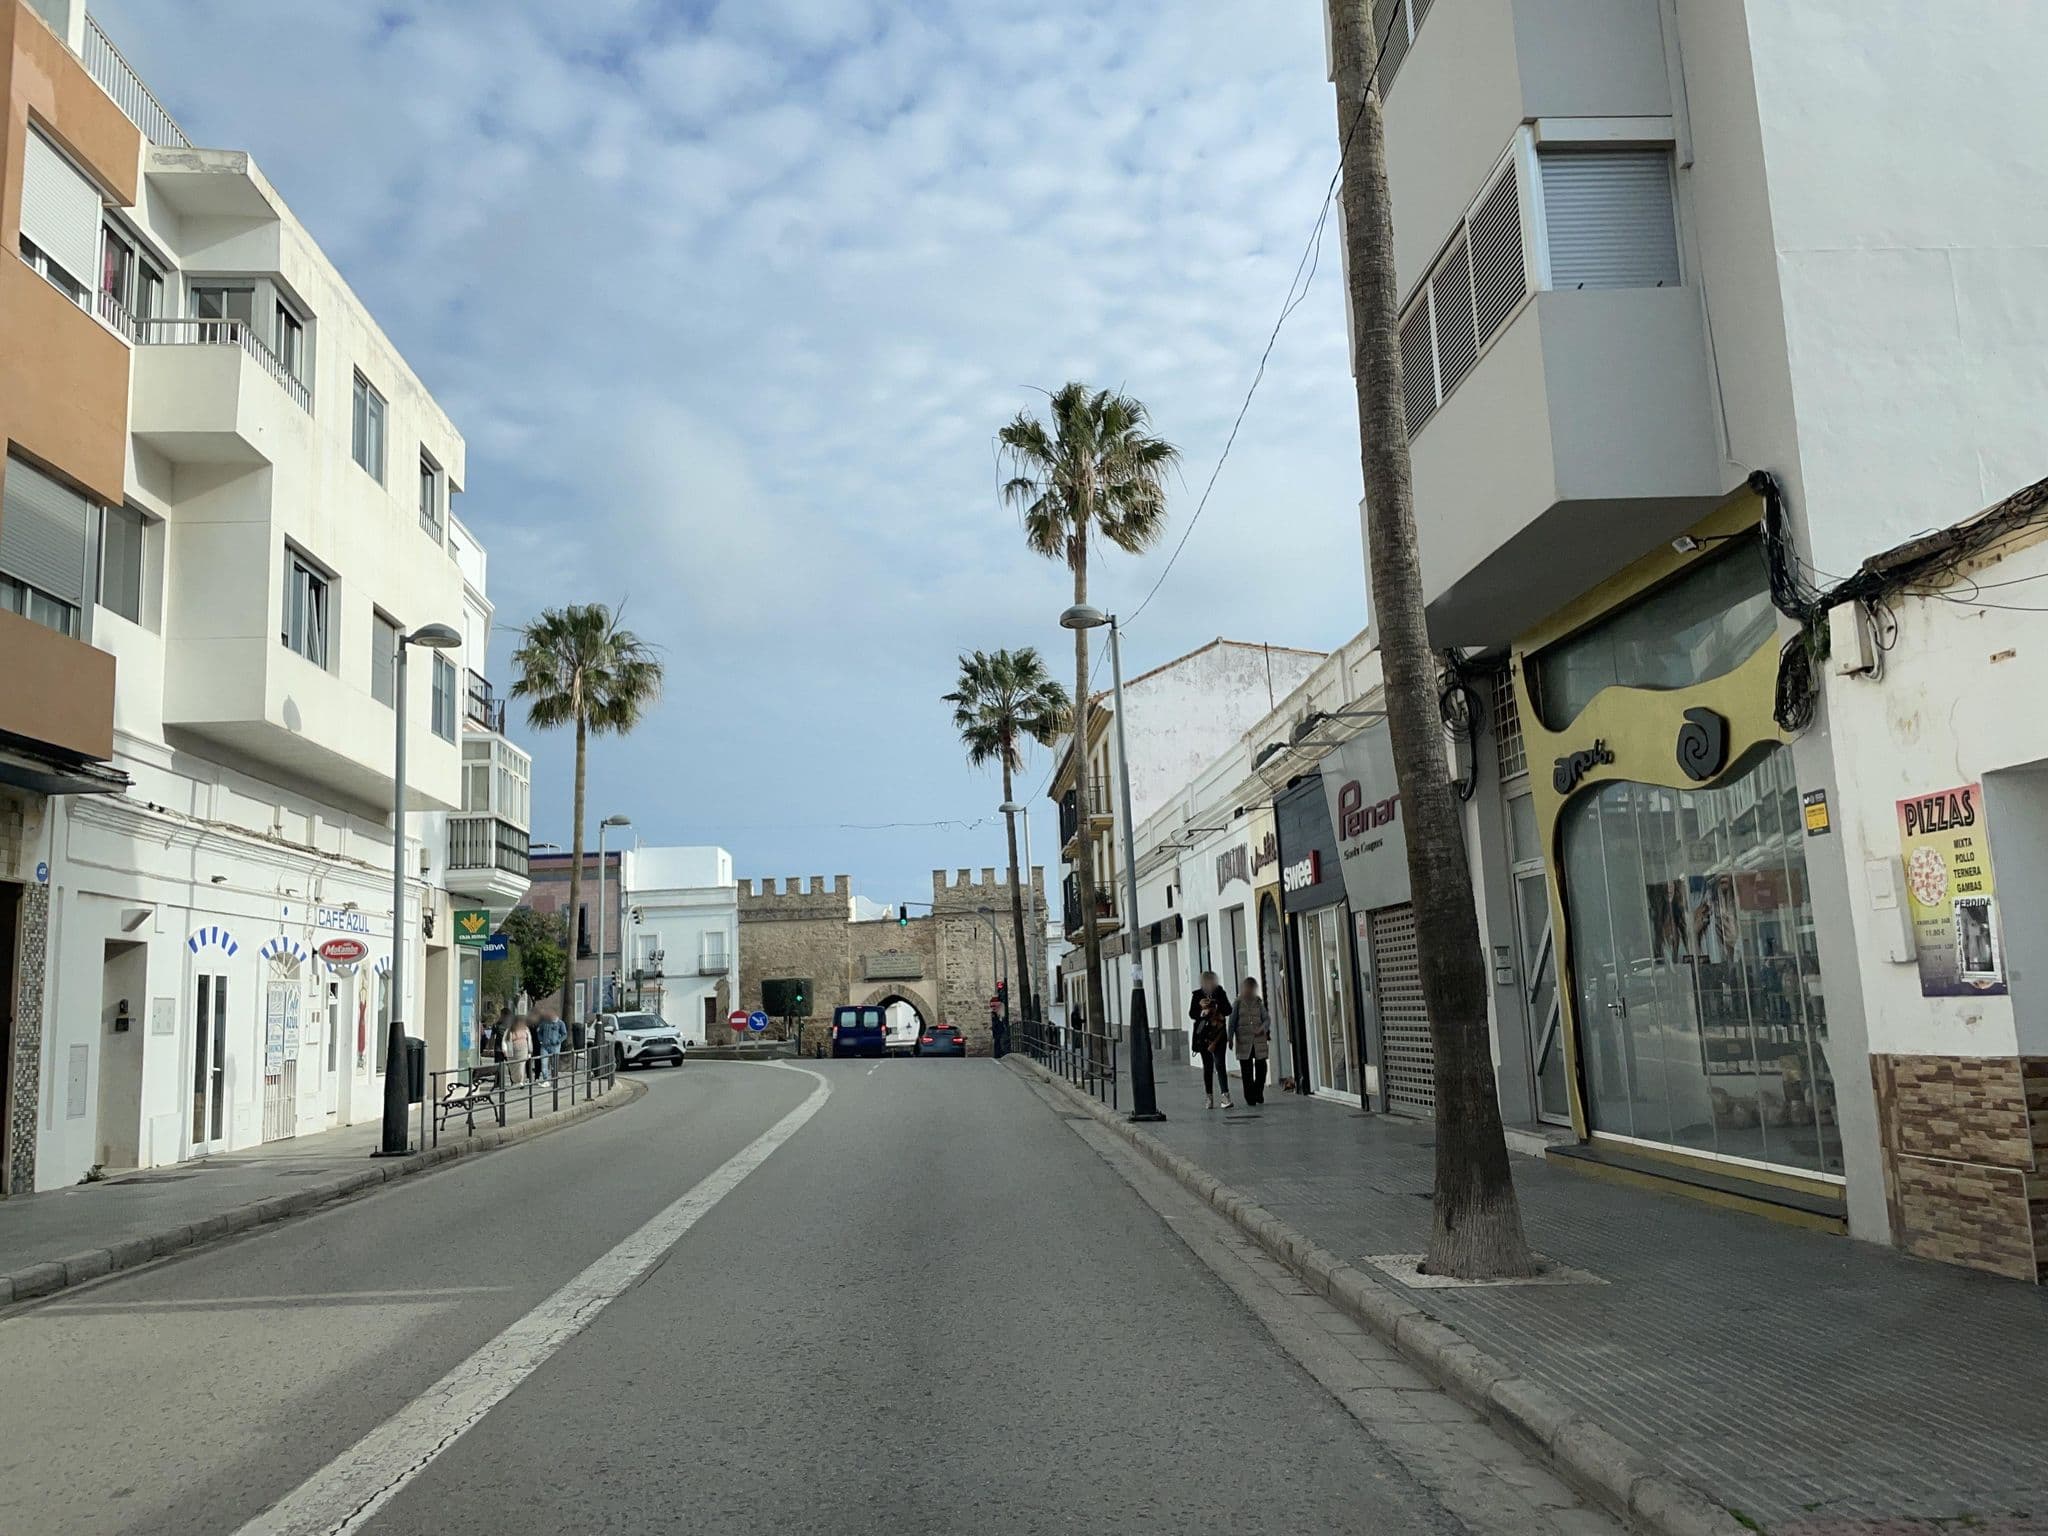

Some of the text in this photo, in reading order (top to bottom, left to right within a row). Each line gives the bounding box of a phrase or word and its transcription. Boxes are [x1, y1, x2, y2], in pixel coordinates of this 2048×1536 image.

[1904, 789, 1975, 836] PIZZAS
[1953, 837, 1973, 849] MIXTA
[1955, 852, 1975, 864] POLLO
[1953, 866, 1982, 878] TERNERA
[1957, 881, 1982, 893] GAMBAS
[1954, 897, 1992, 909] PERDIDA
[346, 913, 370, 932] AZUL
